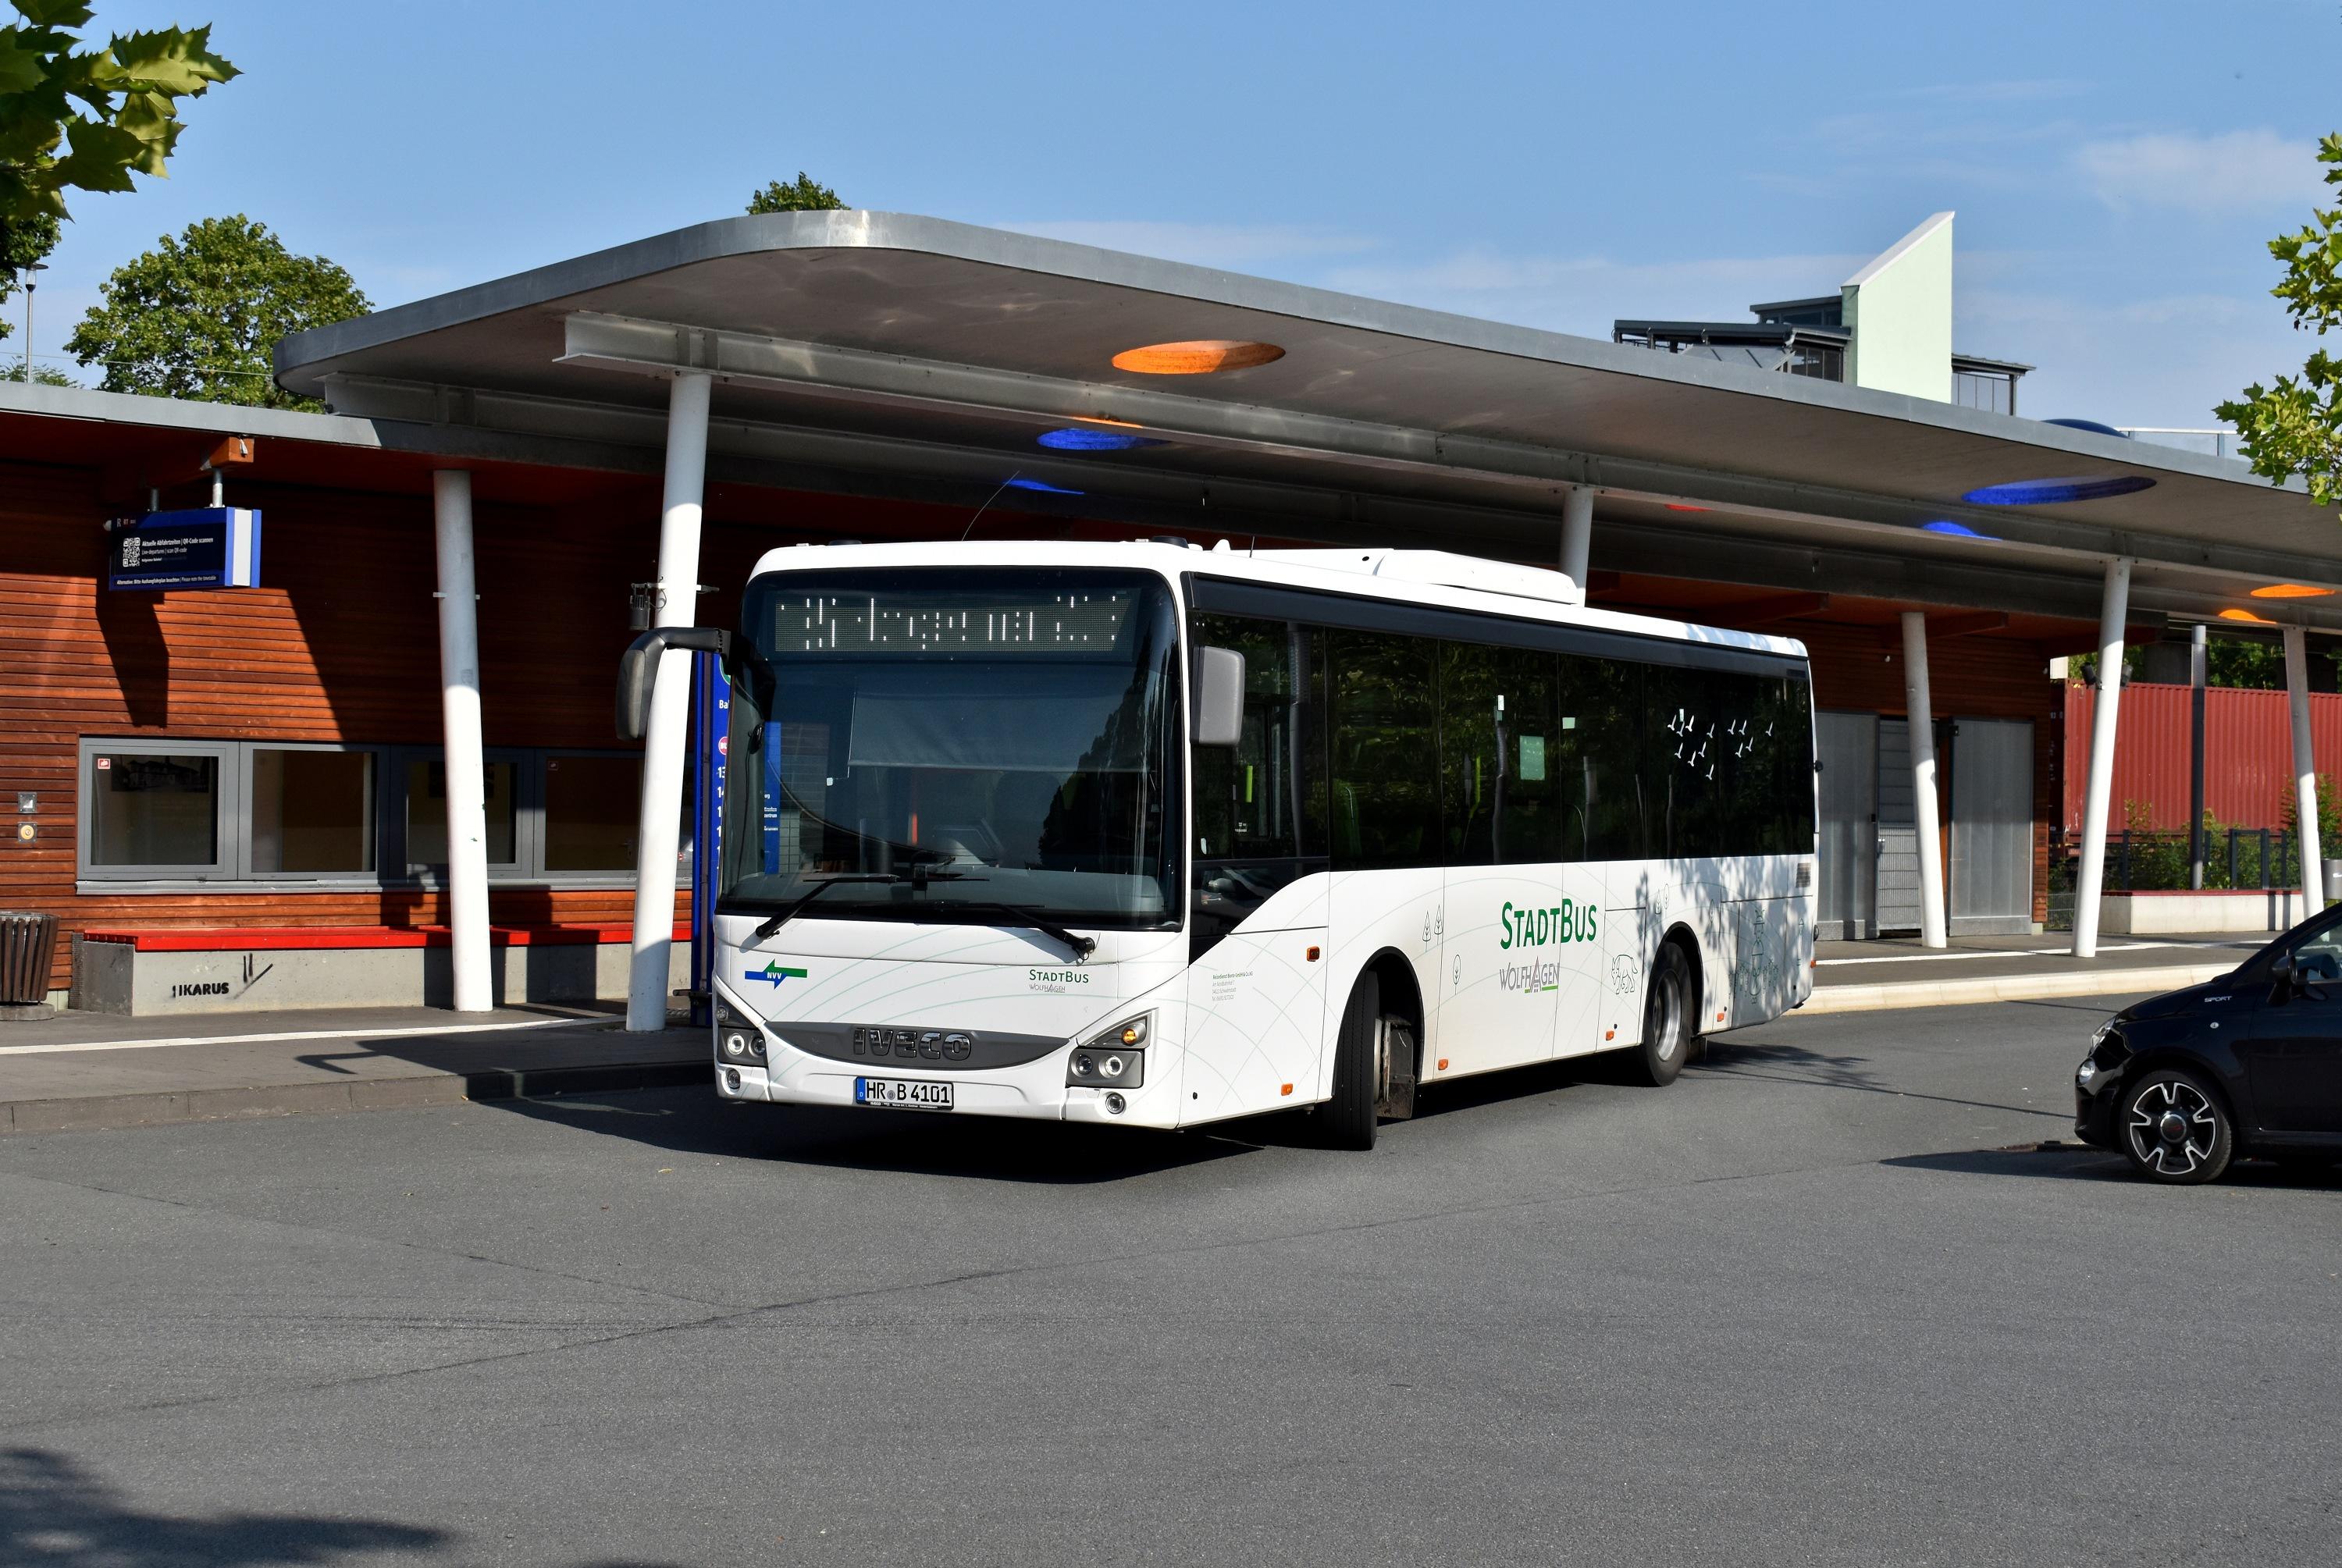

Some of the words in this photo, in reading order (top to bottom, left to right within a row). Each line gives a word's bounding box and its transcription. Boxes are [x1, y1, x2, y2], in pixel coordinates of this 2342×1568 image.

[719, 699, 729, 709] Ba
[1499, 956, 1561, 993] WOLFHAGEN
[1029, 983, 1066, 992] WOLFHAGEN
[853, 1028, 971, 1061] IVECO
[867, 1082, 885, 1100] HR
[897, 1083, 907, 1100] B
[910, 1084, 950, 1104] 4101
